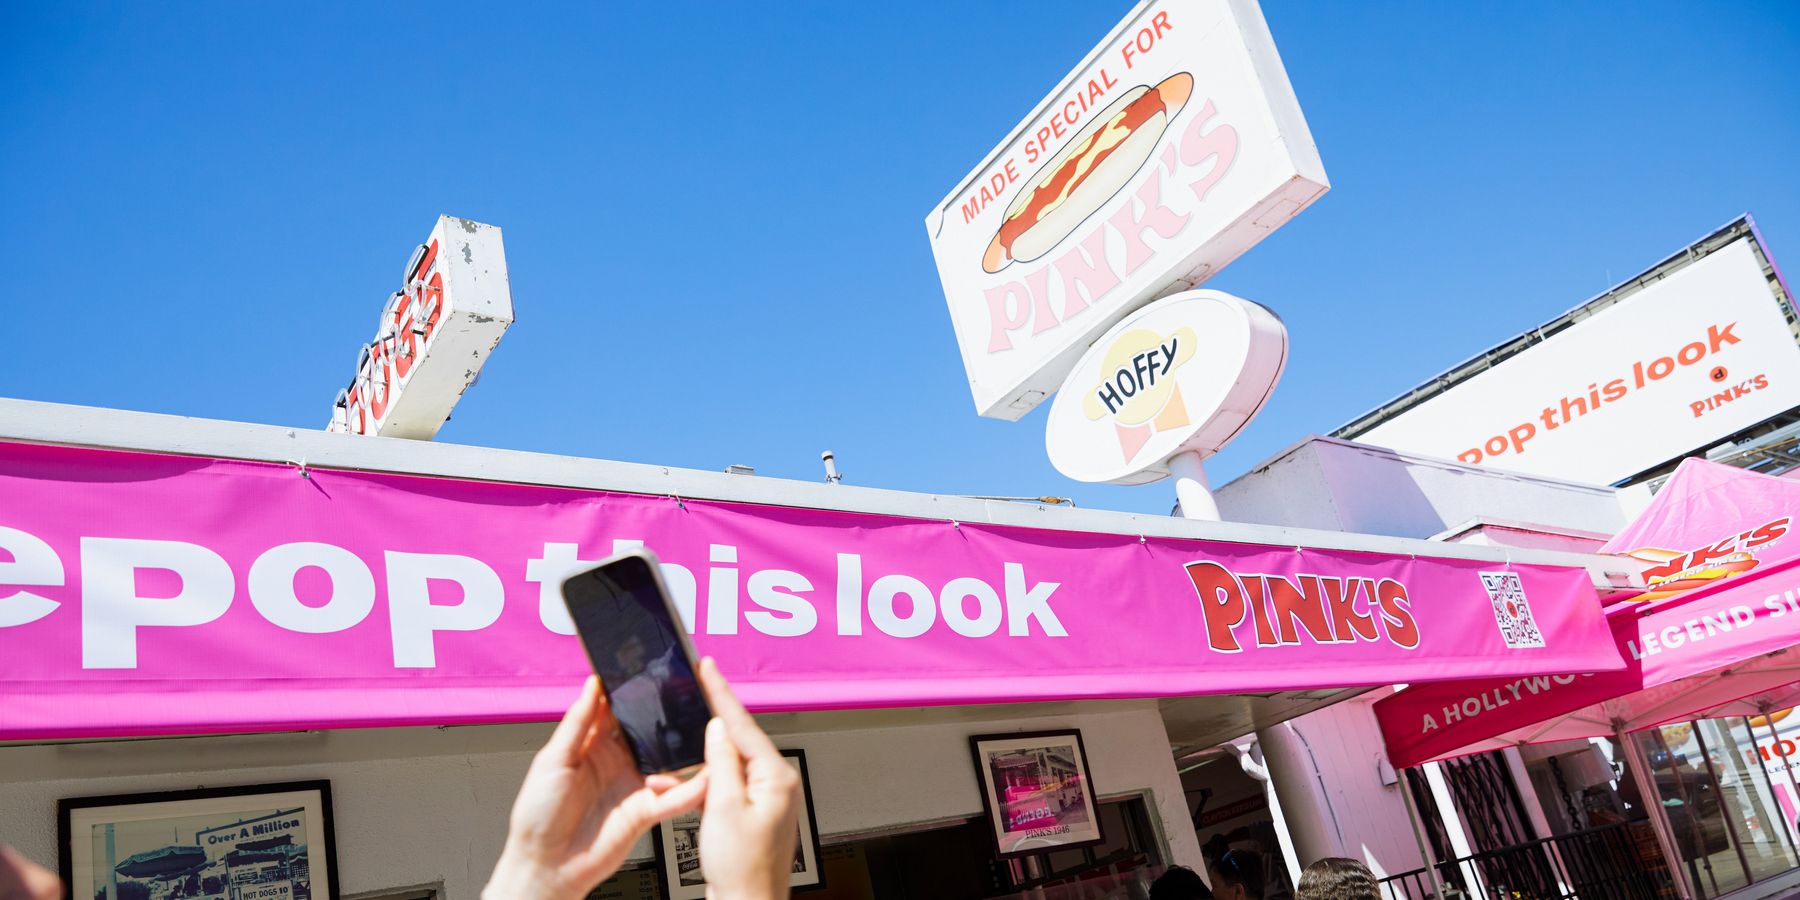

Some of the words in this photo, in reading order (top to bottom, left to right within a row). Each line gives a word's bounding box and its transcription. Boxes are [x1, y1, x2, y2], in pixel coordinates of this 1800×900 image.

[962, 157, 1020, 225] MADE
[1024, 68, 1117, 164] SPECIAL
[1121, 10, 1174, 69] FOR
[983, 98, 1241, 355] PINK'S
[1098, 338, 1178, 414] HOFFY
[1540, 379, 1628, 431] this
[1633, 321, 1742, 390] look
[1689, 373, 1769, 418] PINK'S
[837, 553, 1069, 638] look
[1183, 559, 1421, 653] PINK'S
[1627, 605, 1755, 661] LEGEND
[1764, 587, 1800, 618] SI
[1422, 712, 1438, 733] A
[209, 833, 235, 845] Over
[239, 828, 250, 839] A
[252, 819, 298, 835] Million
[1054, 825, 1070, 835] 1946
[259, 887, 277, 898] DOGS
